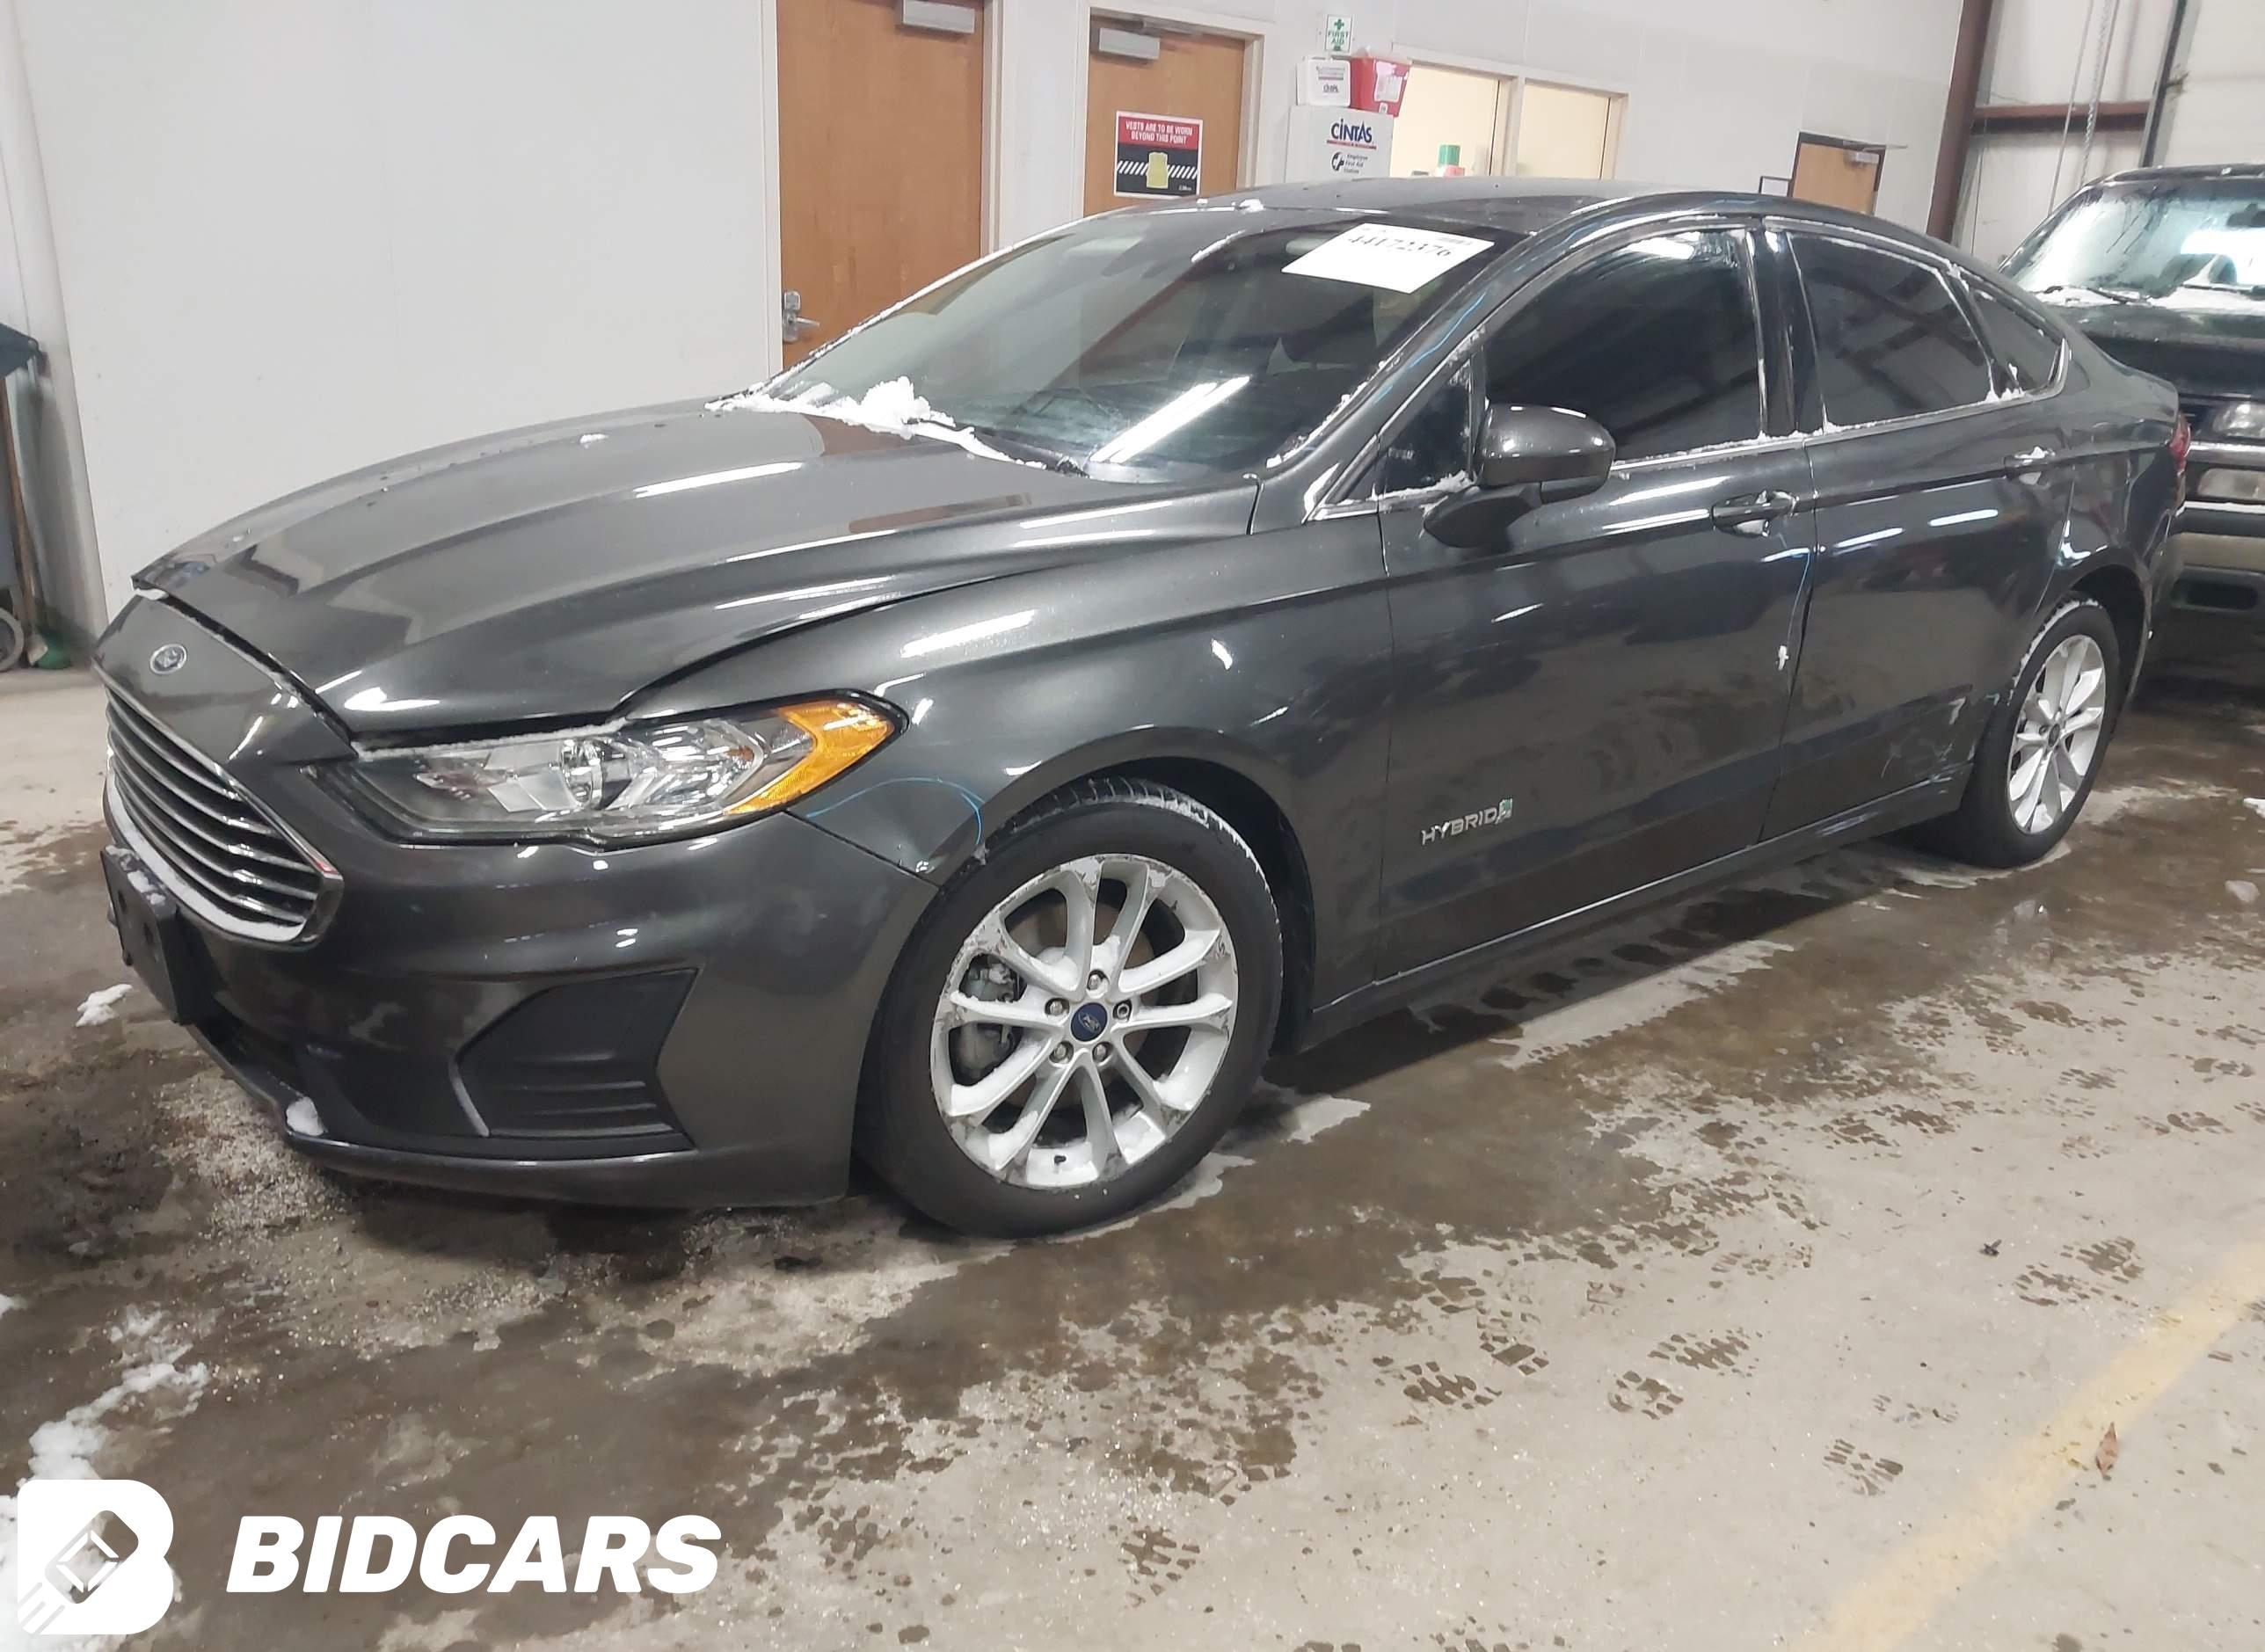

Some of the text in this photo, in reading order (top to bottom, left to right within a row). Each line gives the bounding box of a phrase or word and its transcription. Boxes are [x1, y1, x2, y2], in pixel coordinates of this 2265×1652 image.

[1125, 120, 1143, 130] VESTS
[1145, 122, 1156, 132] ARE
[1158, 124, 1165, 133] TO
[1167, 125, 1173, 134] BE
[1330, 118, 1373, 143] CINTAS
[1131, 131, 1186, 144] BEYOND THIS POINT
[1421, 806, 1498, 846] HYBRID
